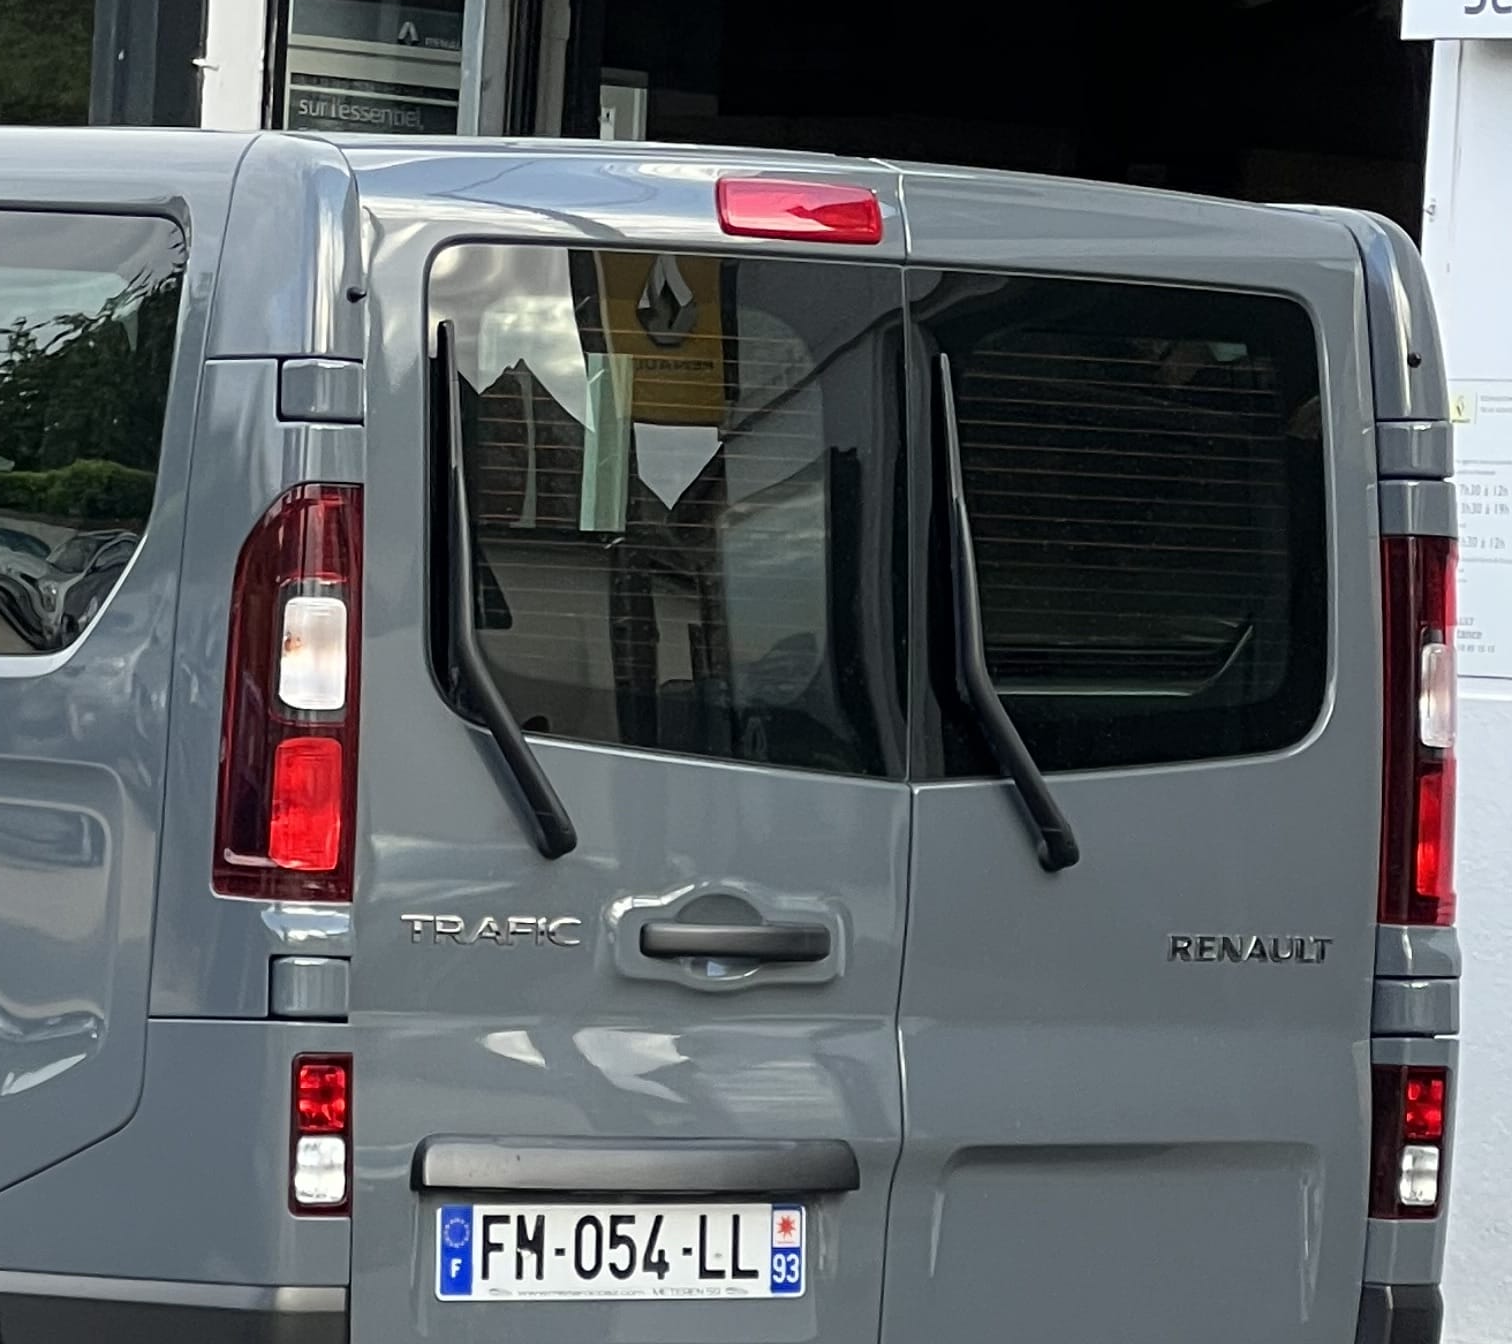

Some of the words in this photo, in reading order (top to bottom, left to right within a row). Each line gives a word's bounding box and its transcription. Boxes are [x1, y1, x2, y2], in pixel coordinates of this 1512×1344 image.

[299, 98, 327, 117] sur
[400, 913, 582, 946] TRAFIC
[1167, 934, 1333, 963] RENAULT
[451, 1258, 462, 1278] F
[481, 1214, 759, 1280] FM-054-LL
[773, 1253, 799, 1283] 93
